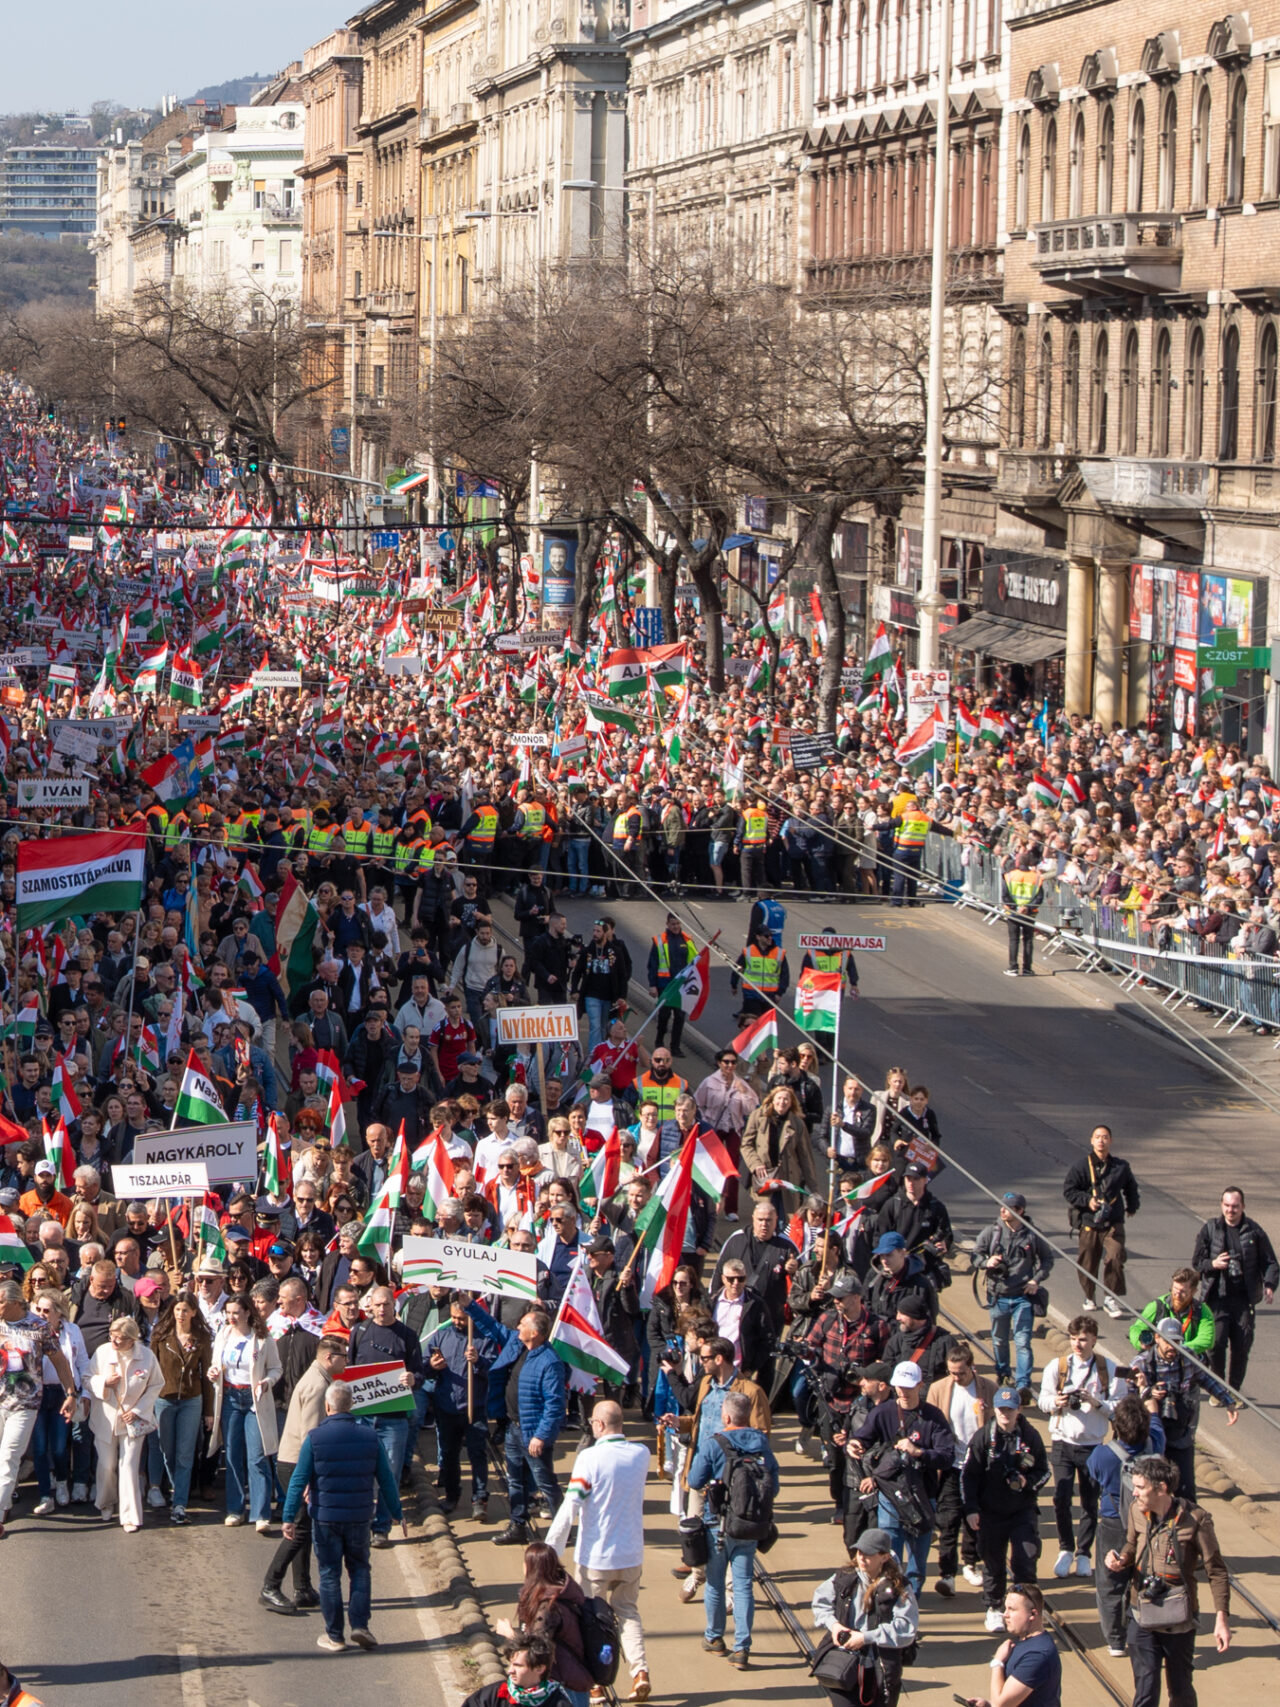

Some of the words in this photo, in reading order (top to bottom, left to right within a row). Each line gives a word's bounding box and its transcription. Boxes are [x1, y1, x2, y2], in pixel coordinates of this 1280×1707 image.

[621, 661, 670, 679] AJA
[514, 734, 545, 745] MONOR
[42, 784, 82, 798] IVÁN
[799, 934, 884, 950] KISKUNMAJSA
[501, 1010, 574, 1041] NYÍRKÁTA
[144, 1139, 245, 1165] NAGYKÁROLY
[128, 1171, 192, 1188] TISZAALPÁR
[442, 1244, 499, 1264] GYULAJ
[349, 1376, 386, 1396] AJRÁ,
